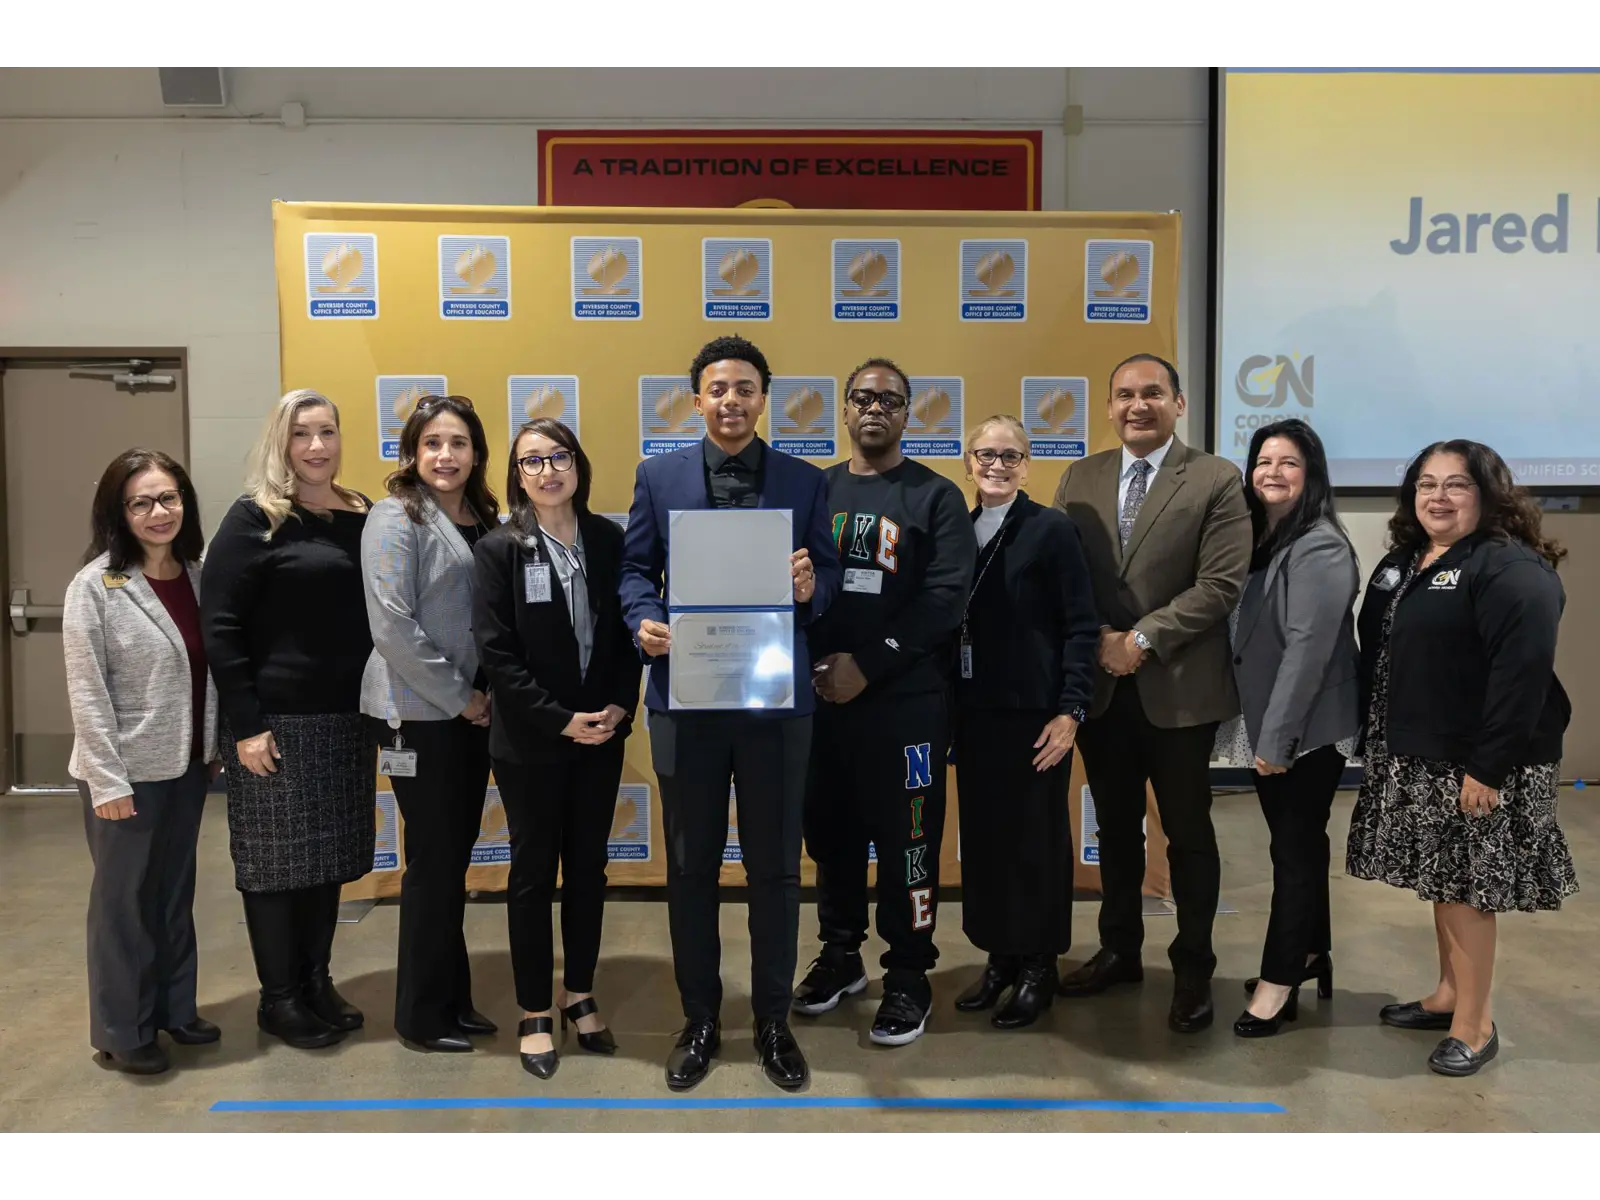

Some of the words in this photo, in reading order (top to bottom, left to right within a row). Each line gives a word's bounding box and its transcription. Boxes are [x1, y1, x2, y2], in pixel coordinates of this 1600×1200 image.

[573, 158, 593, 176] A
[600, 158, 762, 176] TRADITION
[769, 158, 809, 176] OF
[815, 158, 1009, 176] EXCELLENCE
[1389, 193, 1569, 255] Jared
[1518, 464, 1575, 476] UNIFIED
[905, 743, 933, 931] NIKE
